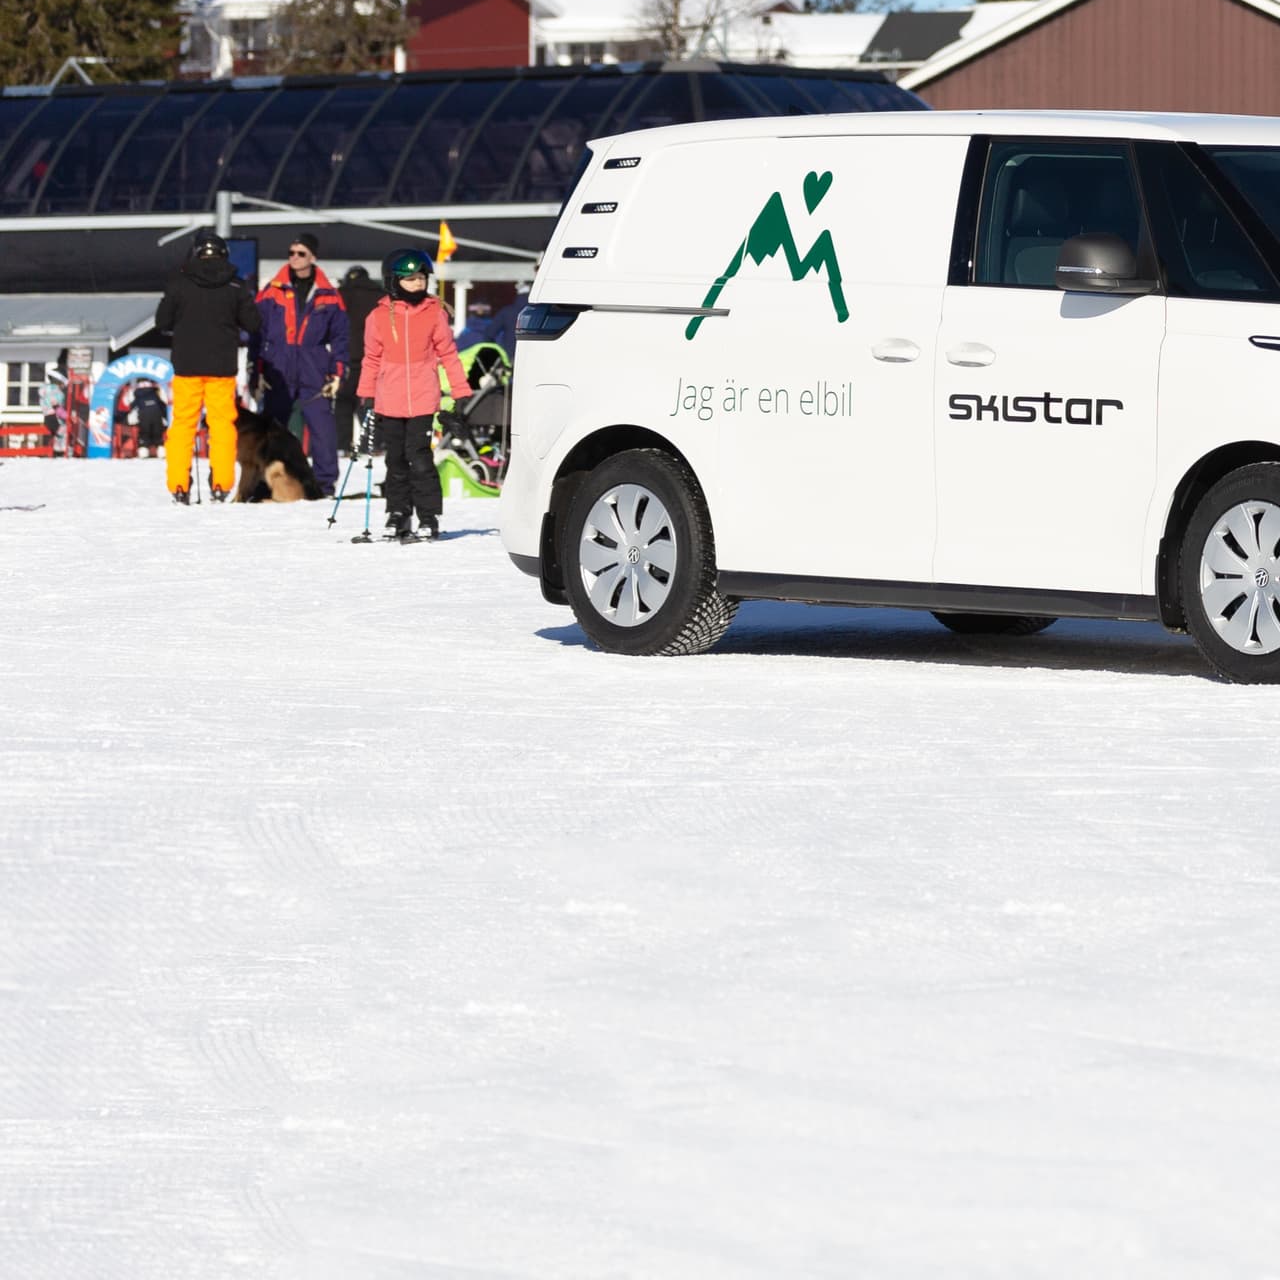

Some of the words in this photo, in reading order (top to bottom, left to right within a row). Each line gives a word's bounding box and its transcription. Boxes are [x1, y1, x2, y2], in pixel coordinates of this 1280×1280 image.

[107, 356, 170, 379] VALLE
[669, 377, 714, 421] Jag
[723, 378, 749, 412] är
[758, 387, 789, 414] en
[799, 380, 852, 417] elbil
